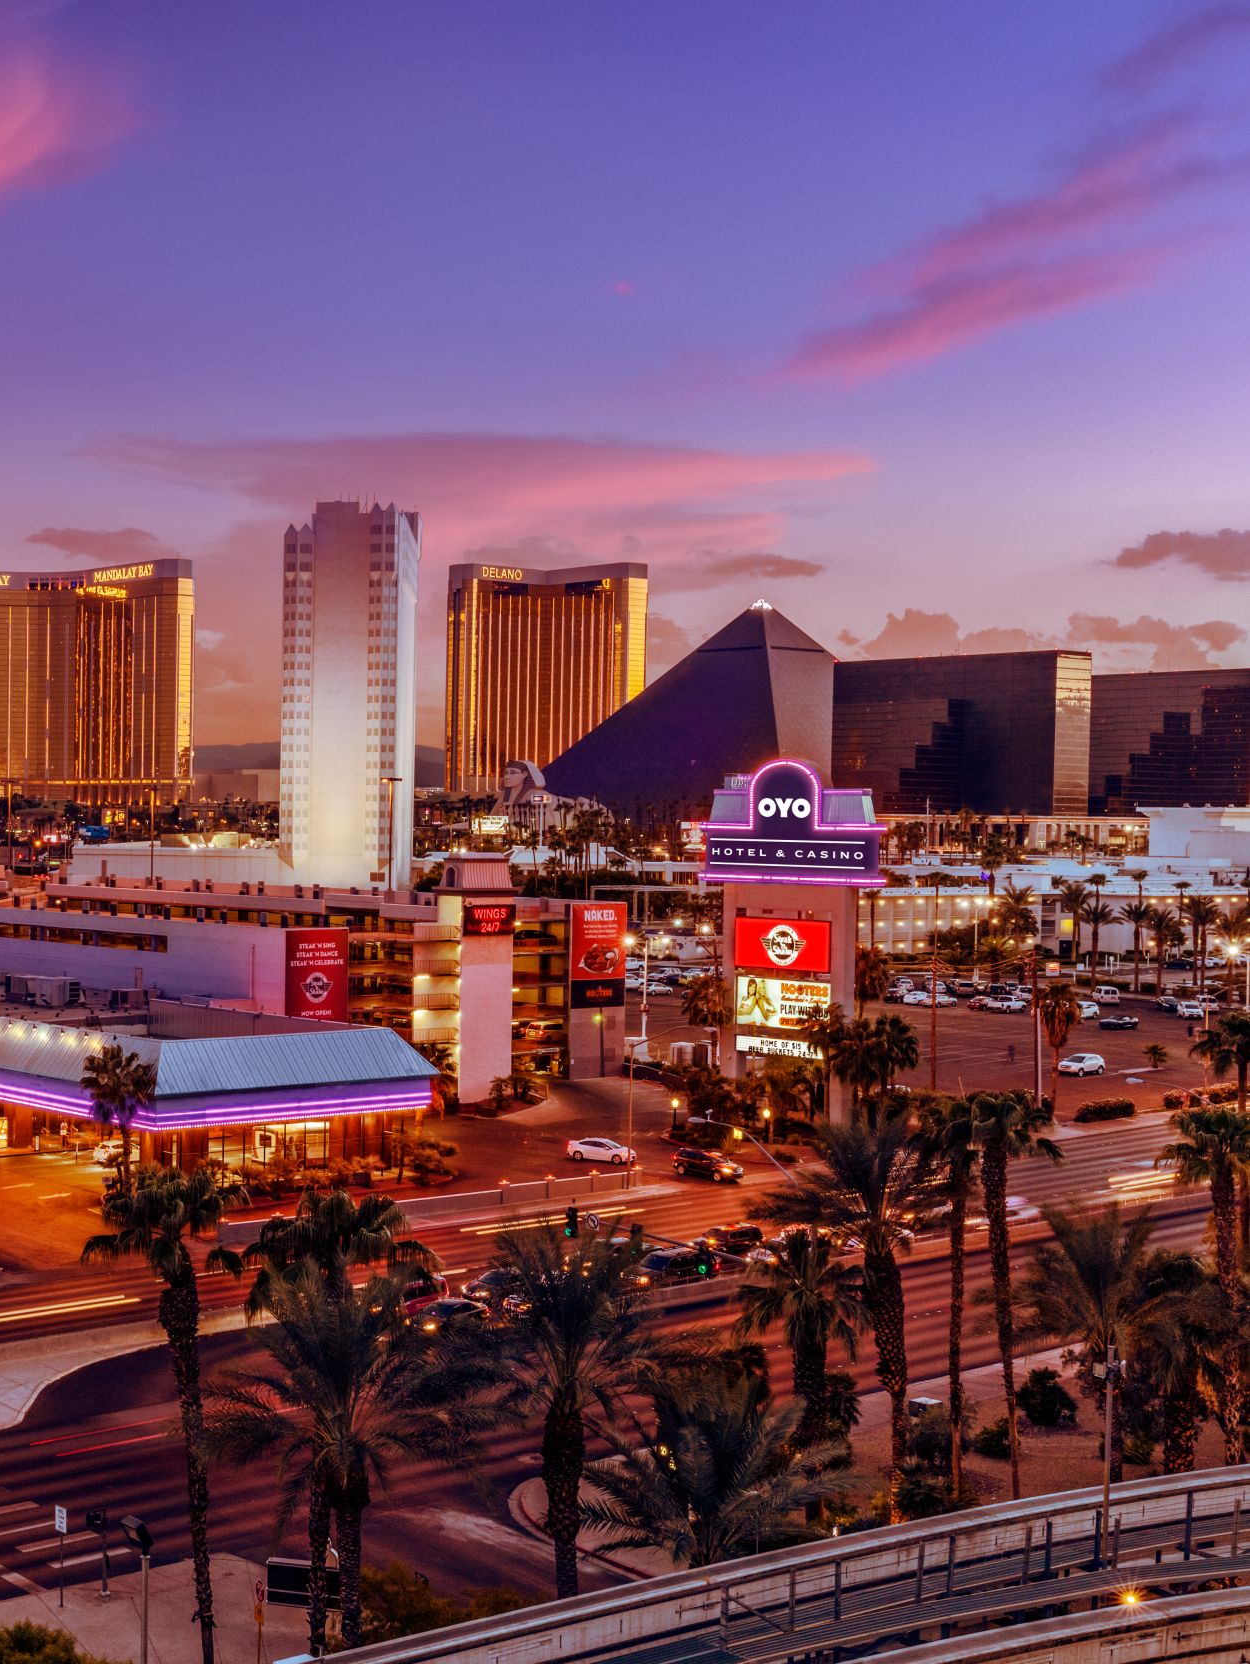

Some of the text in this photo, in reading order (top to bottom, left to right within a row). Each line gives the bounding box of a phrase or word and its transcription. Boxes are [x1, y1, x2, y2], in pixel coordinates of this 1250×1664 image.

[93, 564, 154, 582] MANDALAY BAY
[482, 566, 523, 581] DELANO
[758, 797, 811, 819] OYO
[711, 847, 864, 860] HOTEL & CASINO
[474, 908, 507, 919] WINGS
[584, 909, 618, 921] NAKED.
[481, 922, 500, 933] 24/7
[781, 983, 828, 997] HOOTERS
[780, 1004, 796, 1015] PLAY
[760, 1039, 778, 1047] HOME
[749, 1045, 764, 1053] BEER
[767, 1047, 794, 1056] BUCKETS
